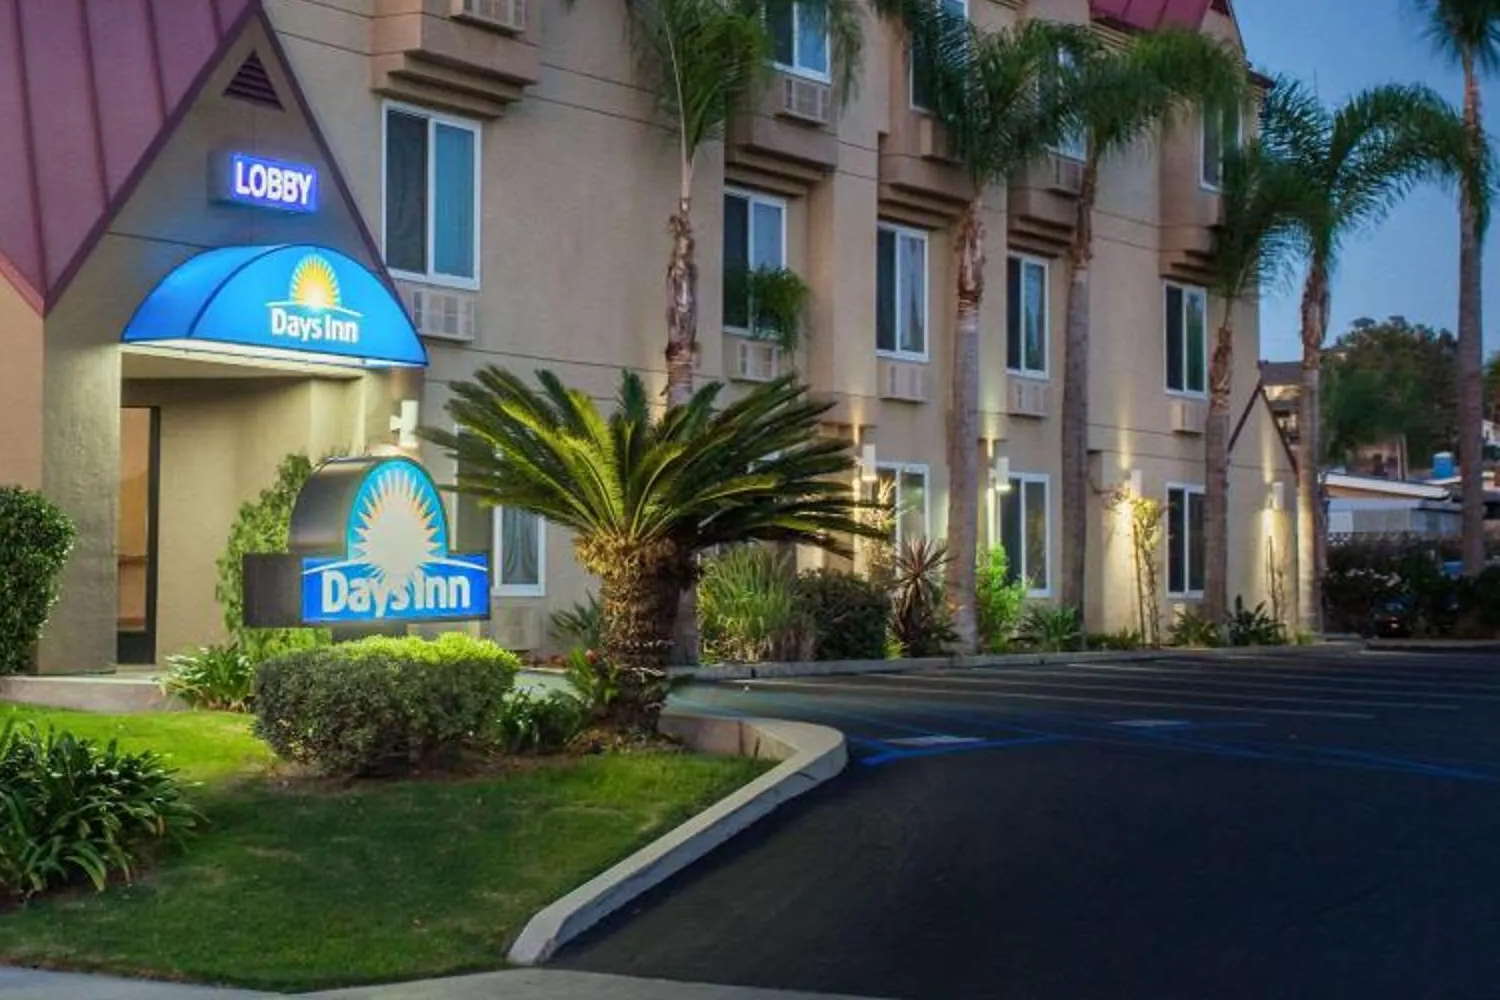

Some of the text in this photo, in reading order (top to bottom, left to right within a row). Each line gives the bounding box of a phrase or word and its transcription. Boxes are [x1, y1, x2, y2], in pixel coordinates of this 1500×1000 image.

[235, 160, 313, 205] LOBBY
[271, 307, 358, 344] Days Inn
[322, 569, 471, 618] Days Inn
